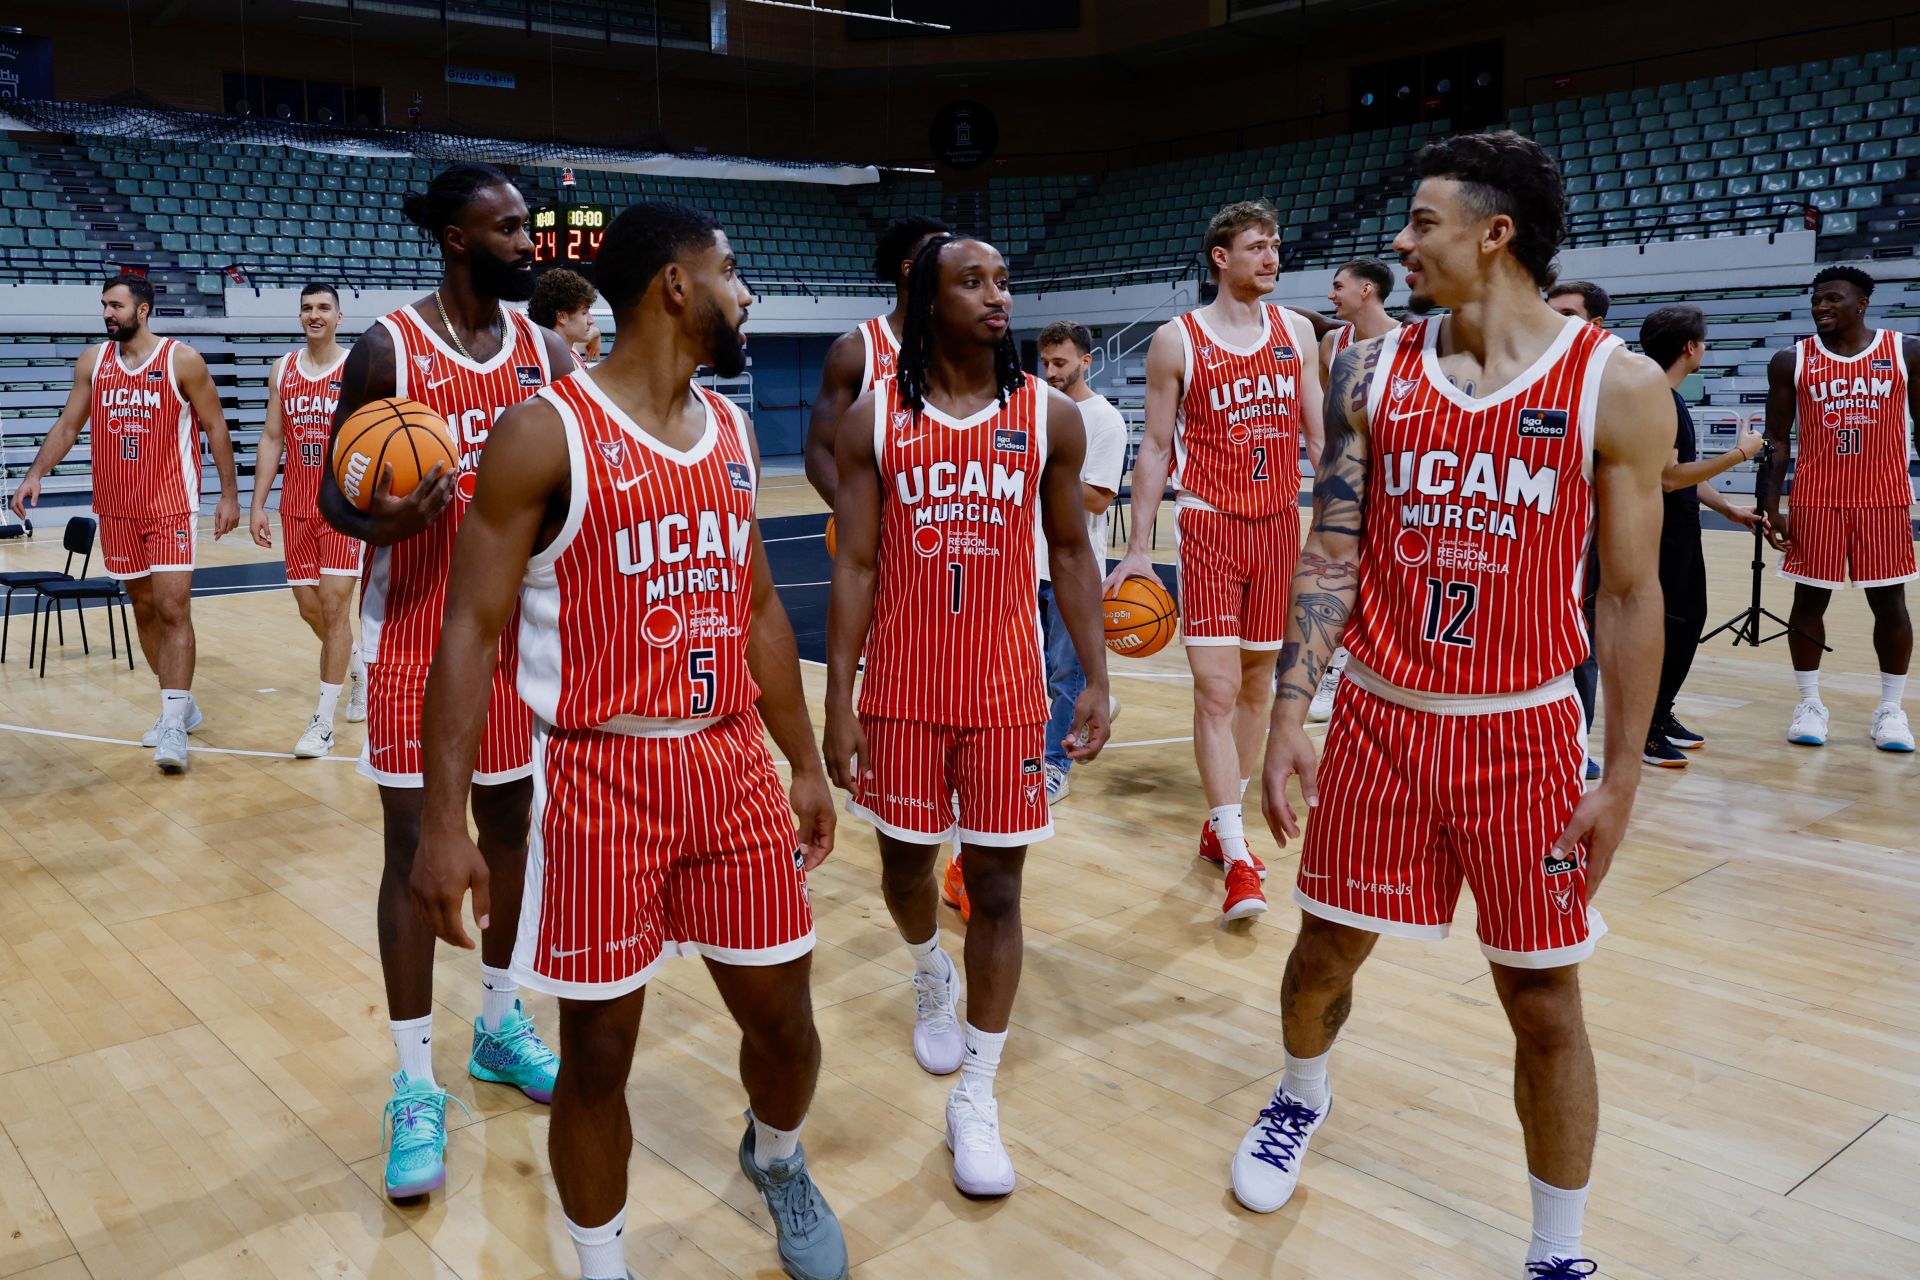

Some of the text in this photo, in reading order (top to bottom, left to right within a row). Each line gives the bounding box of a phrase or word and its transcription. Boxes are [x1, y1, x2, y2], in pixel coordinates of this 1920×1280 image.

[537, 211, 555, 228] 10:00
[571, 210, 603, 227] 10:00
[535, 231, 555, 261] 24
[102, 388, 160, 410] UCAM
[1210, 373, 1295, 411] UCAM
[1810, 376, 1892, 402] UCAM
[109, 408, 151, 419] MURCIA
[285, 395, 339, 416] UCAM
[1228, 402, 1289, 425] MURCIA
[1824, 398, 1879, 413] MURCIA
[292, 414, 331, 426] MURCIA
[1522, 416, 1542, 427] liga
[1522, 425, 1563, 435] endesa
[121, 435, 140, 460] 15
[997, 435, 1010, 444] liga
[997, 442, 1024, 450] endesa
[1836, 428, 1861, 455] 31
[301, 442, 323, 467] 99
[1252, 447, 1269, 482] 2
[896, 460, 1026, 508] UCAM
[1383, 449, 1558, 516] UCAM
[915, 503, 1005, 527] MURCIA
[1401, 504, 1519, 540] MURCIA
[615, 510, 751, 576] UCAM
[948, 546, 1001, 557] DE MURCIA
[1437, 547, 1488, 561] REGIÓN
[1436, 557, 1510, 574] DE MURCIA
[646, 567, 738, 605] MURCIA
[948, 562, 963, 614] 1
[1423, 576, 1479, 649] 12
[688, 648, 716, 718] 5
[1024, 763, 1038, 773] acb
[886, 794, 935, 810] INVERSUS
[1548, 860, 1571, 872] acb
[1346, 877, 1412, 896] INVERSUS
